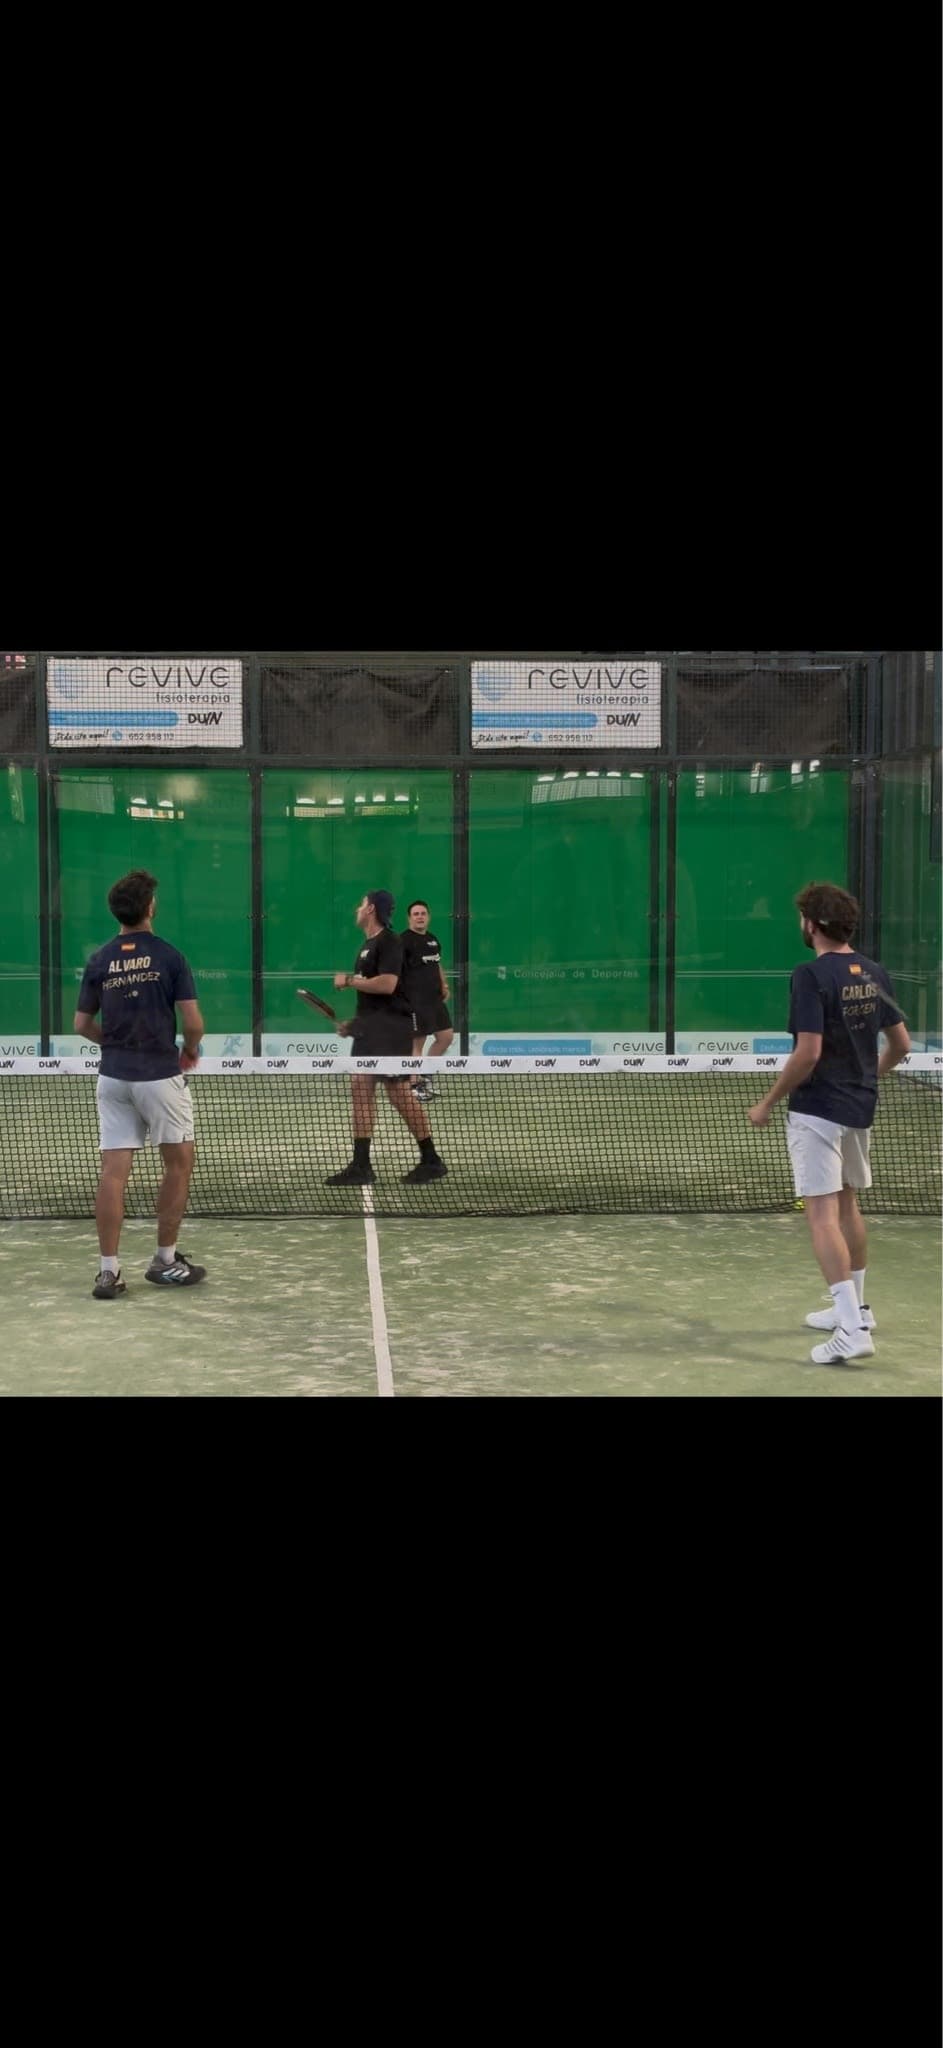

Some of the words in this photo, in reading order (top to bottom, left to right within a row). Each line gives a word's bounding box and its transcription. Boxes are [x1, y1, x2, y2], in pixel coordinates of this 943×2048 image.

[156, 692, 230, 705] fisioterapia
[576, 694, 649, 706] fisioterapia
[108, 956, 152, 974] ALVARO
[572, 969, 585, 979] de
[591, 969, 639, 980] Deportes
[841, 983, 878, 1001] CARLOS
